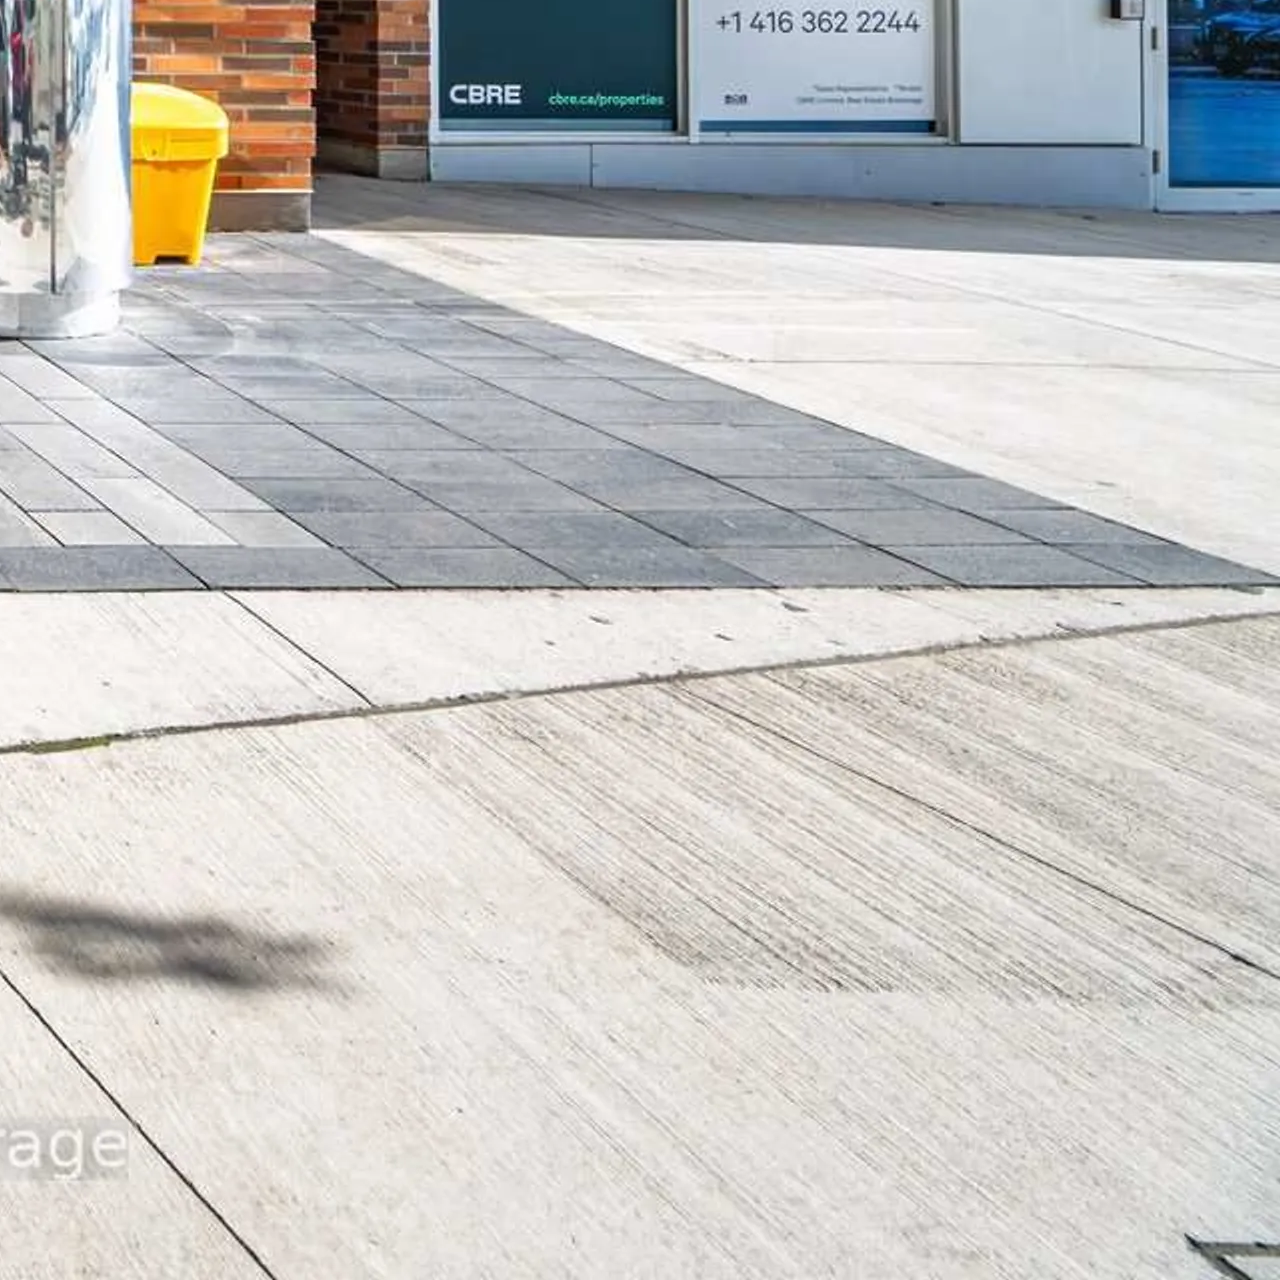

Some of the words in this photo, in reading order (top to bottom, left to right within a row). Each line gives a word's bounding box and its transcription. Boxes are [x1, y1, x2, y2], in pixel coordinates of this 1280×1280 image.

[716, 11, 741, 33] +1
[749, 11, 793, 33] 416
[801, 10, 848, 33] 362
[856, 10, 920, 33] 2244
[449, 84, 522, 105] CBRE
[548, 90, 664, 108] cbre.ca/properties
